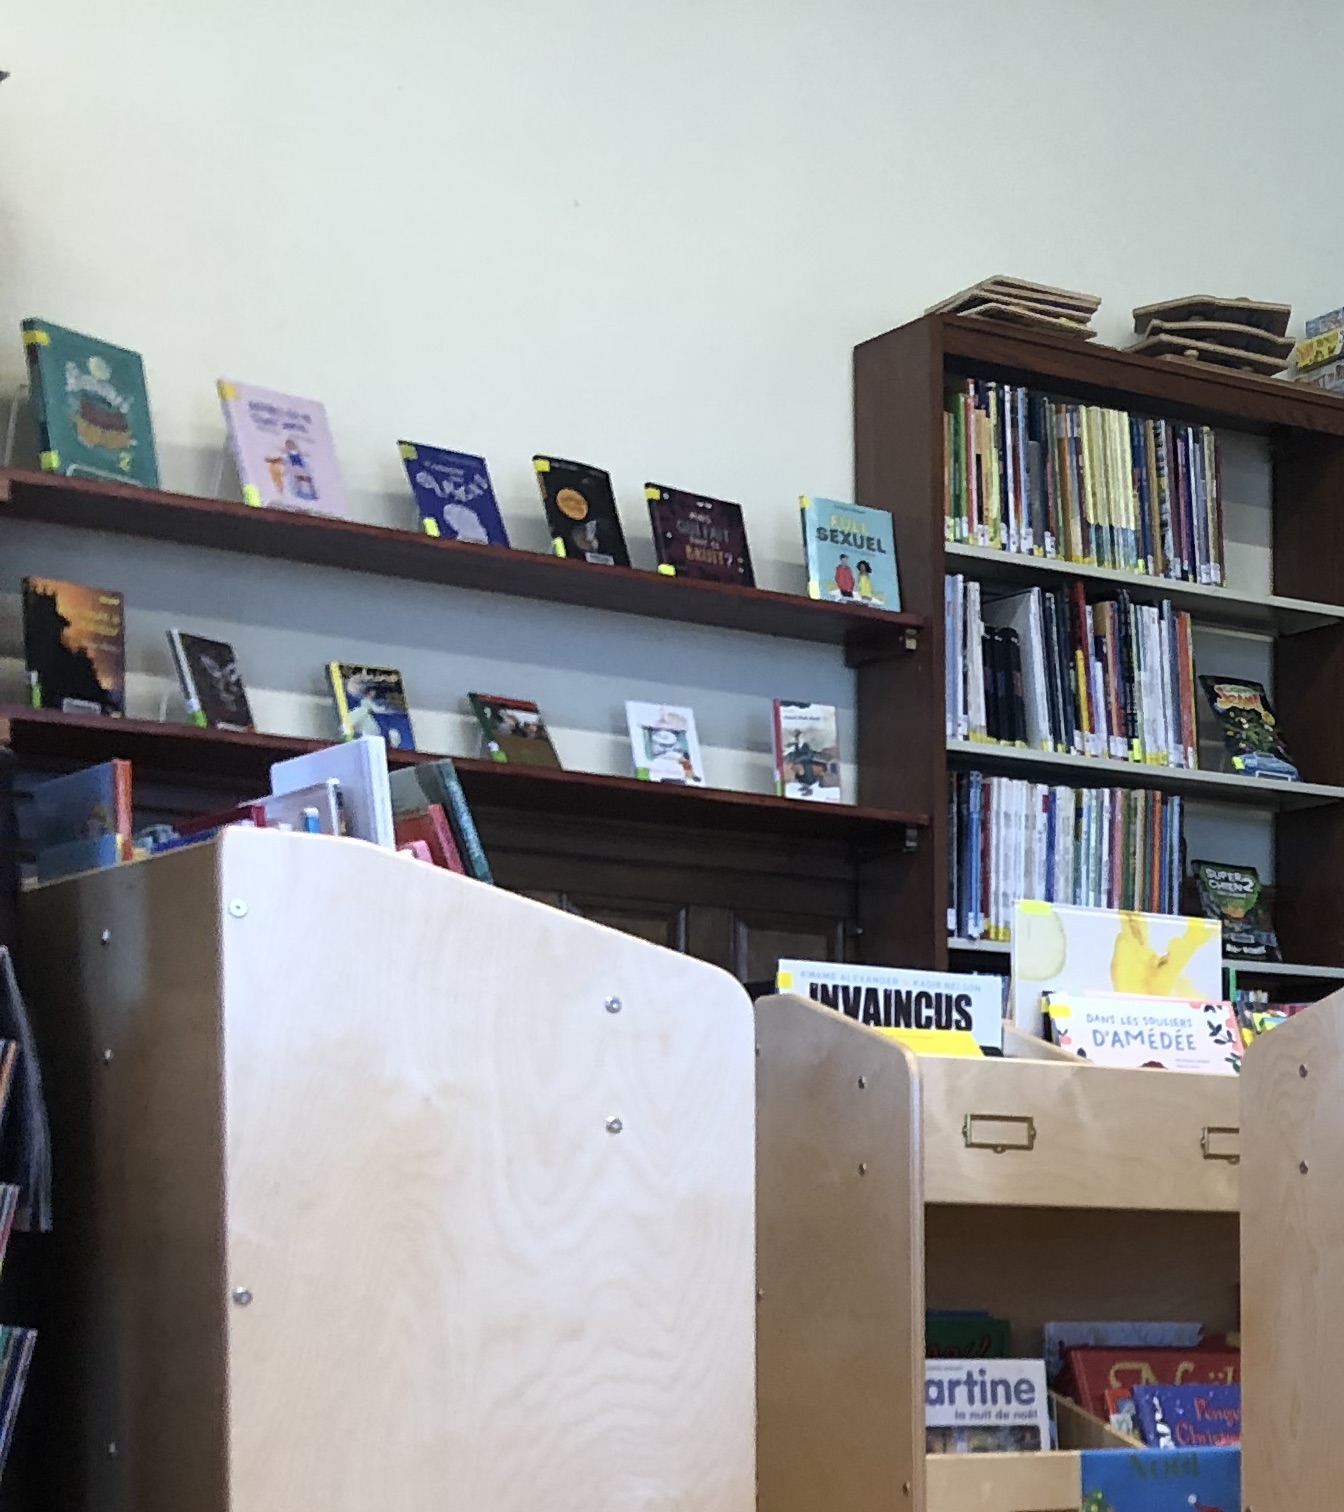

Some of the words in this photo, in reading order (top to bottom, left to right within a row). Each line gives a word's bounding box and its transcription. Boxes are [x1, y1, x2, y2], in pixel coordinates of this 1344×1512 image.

[815, 526, 887, 554] SEXUEL
[1205, 868, 1242, 882] SUPER
[1241, 877, 1255, 893] 2
[840, 973, 900, 987] ALEXANDER
[944, 981, 983, 993] NELSON
[1086, 1013, 1116, 1026] DANS
[1120, 1016, 1139, 1027] LES
[1142, 1016, 1194, 1029] SOULIERS
[1092, 1028, 1198, 1051] D'AMÉDÉE
[925, 1368, 1038, 1407] artine
[969, 1408, 993, 1421] nuit
